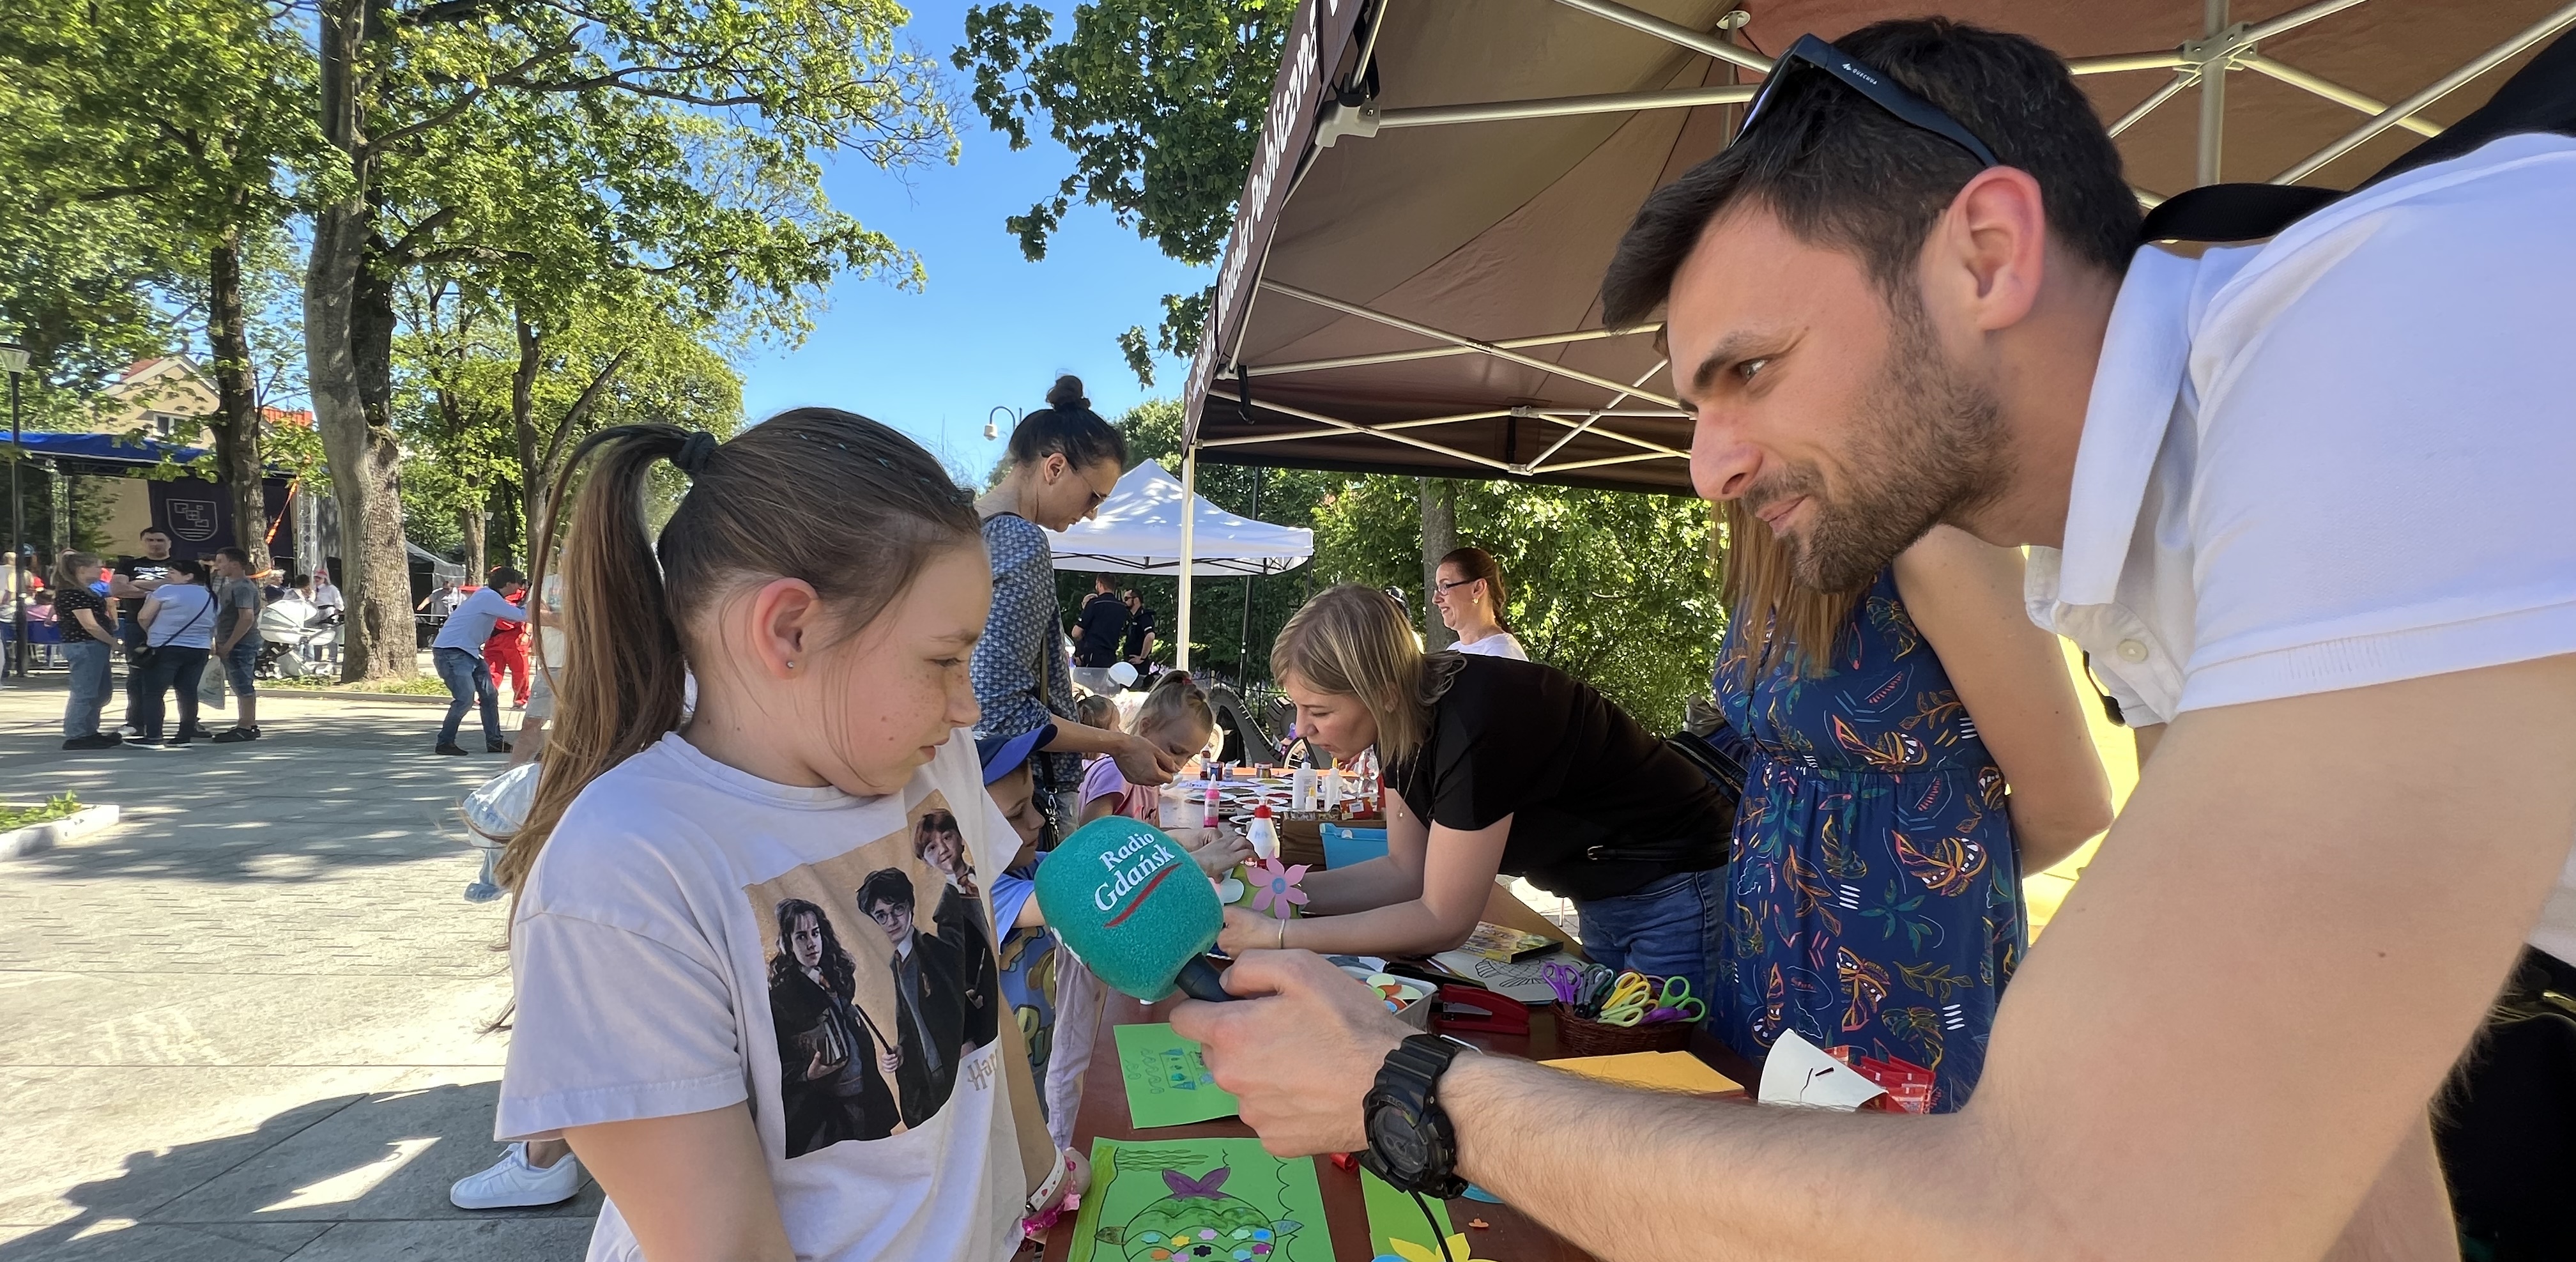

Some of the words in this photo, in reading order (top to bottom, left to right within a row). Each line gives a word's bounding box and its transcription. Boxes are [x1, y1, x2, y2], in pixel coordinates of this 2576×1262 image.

[1211, 216, 1249, 353] blioteka
[1094, 844, 1175, 911] Gdańsk
[1099, 833, 1155, 872] Radio
